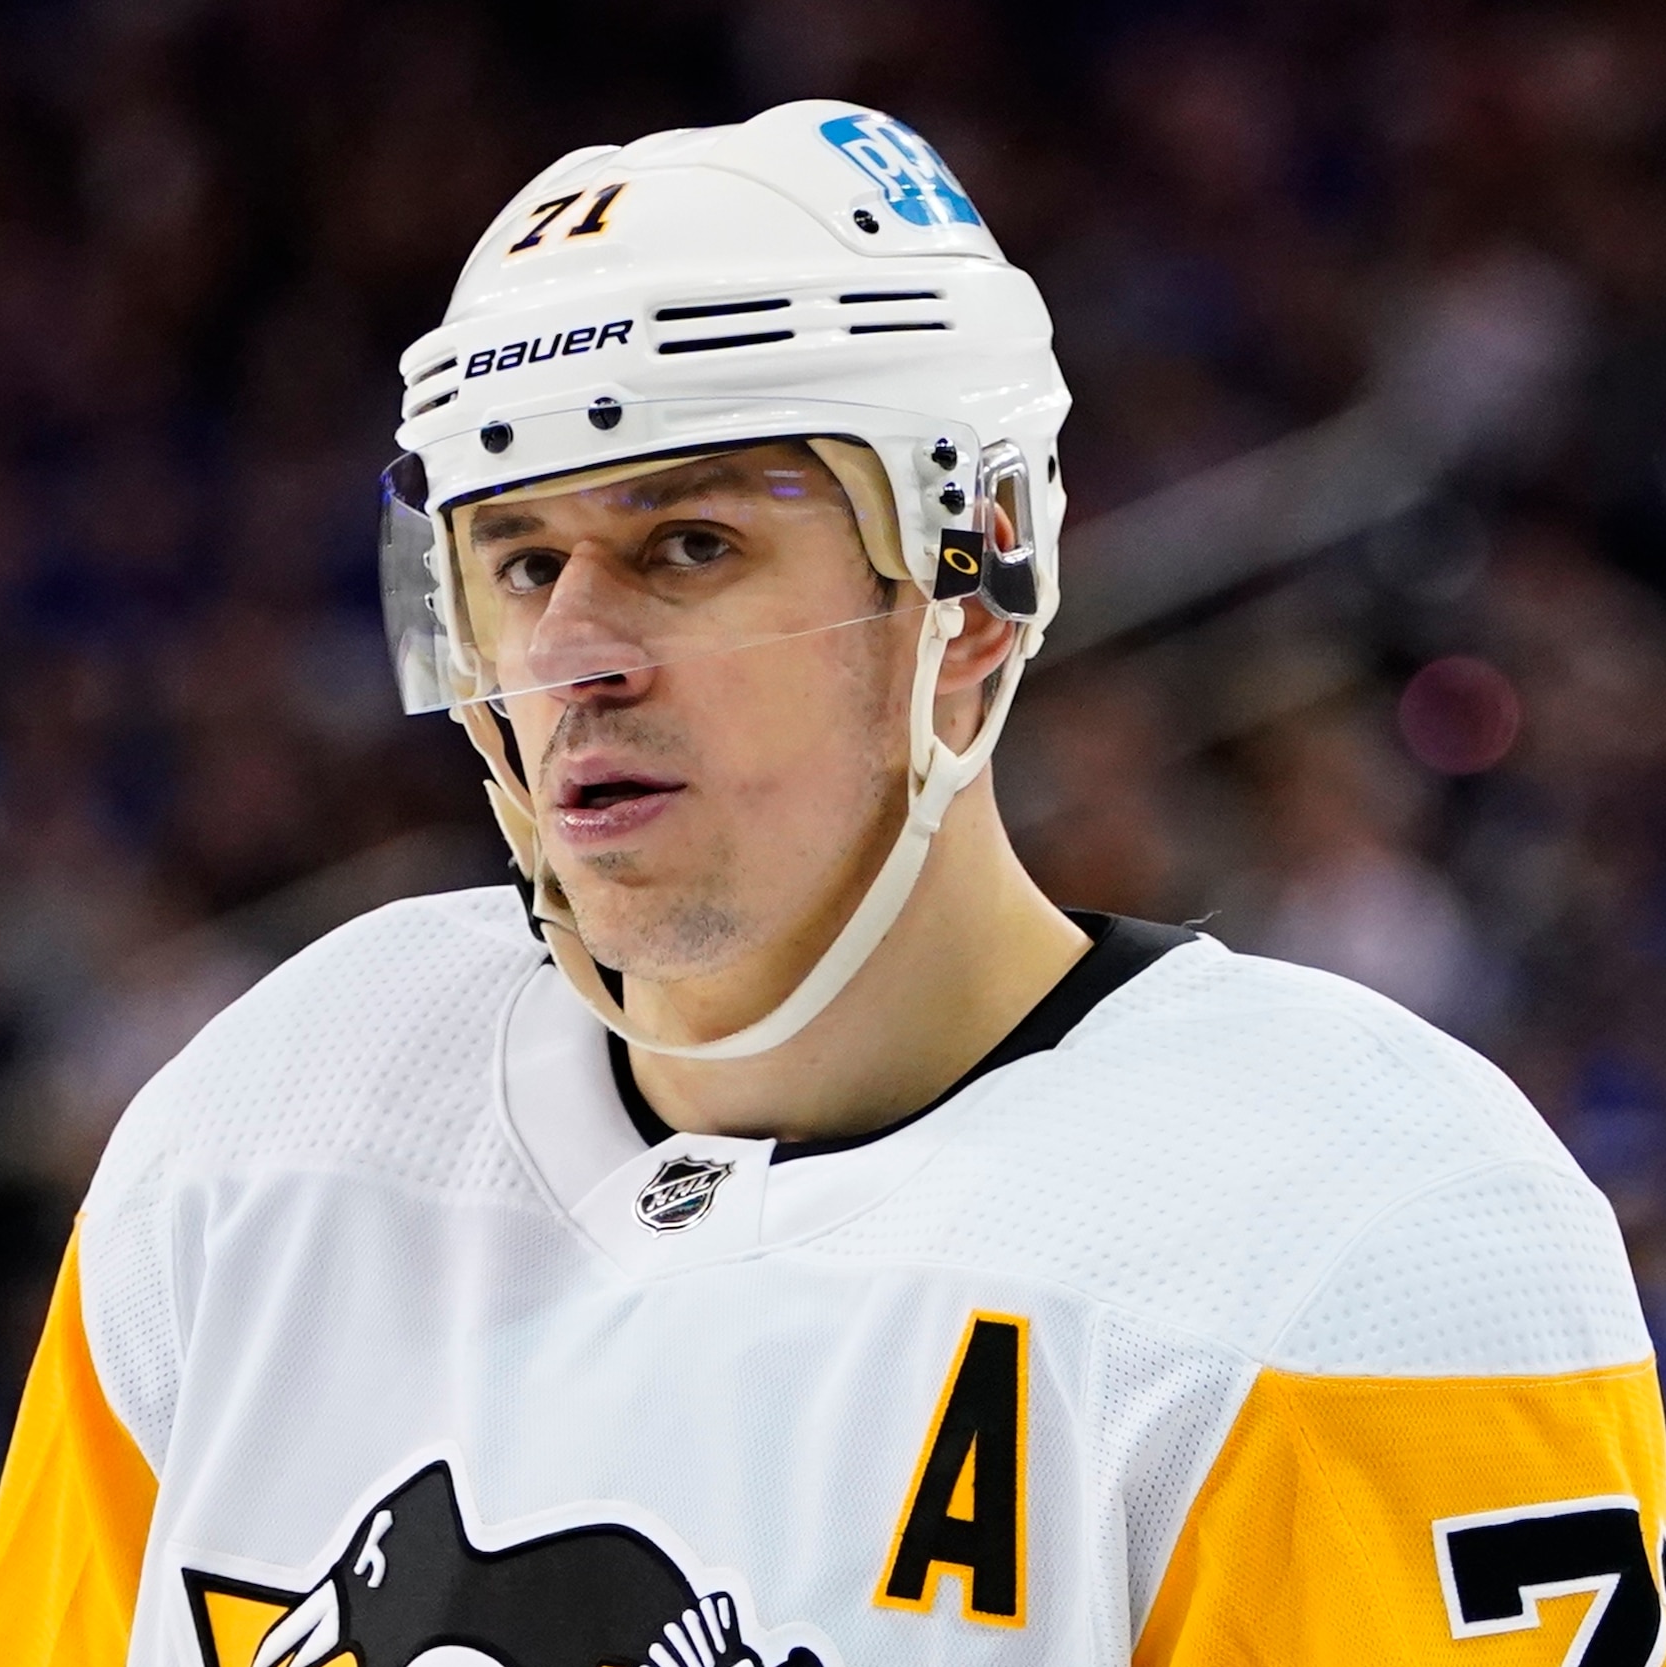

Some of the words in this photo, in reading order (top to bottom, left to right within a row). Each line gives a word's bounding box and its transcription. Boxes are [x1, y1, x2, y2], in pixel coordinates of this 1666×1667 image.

[507, 182, 630, 257] 71
[644, 1175, 711, 1213] NHL
[872, 1309, 1029, 1630] A
